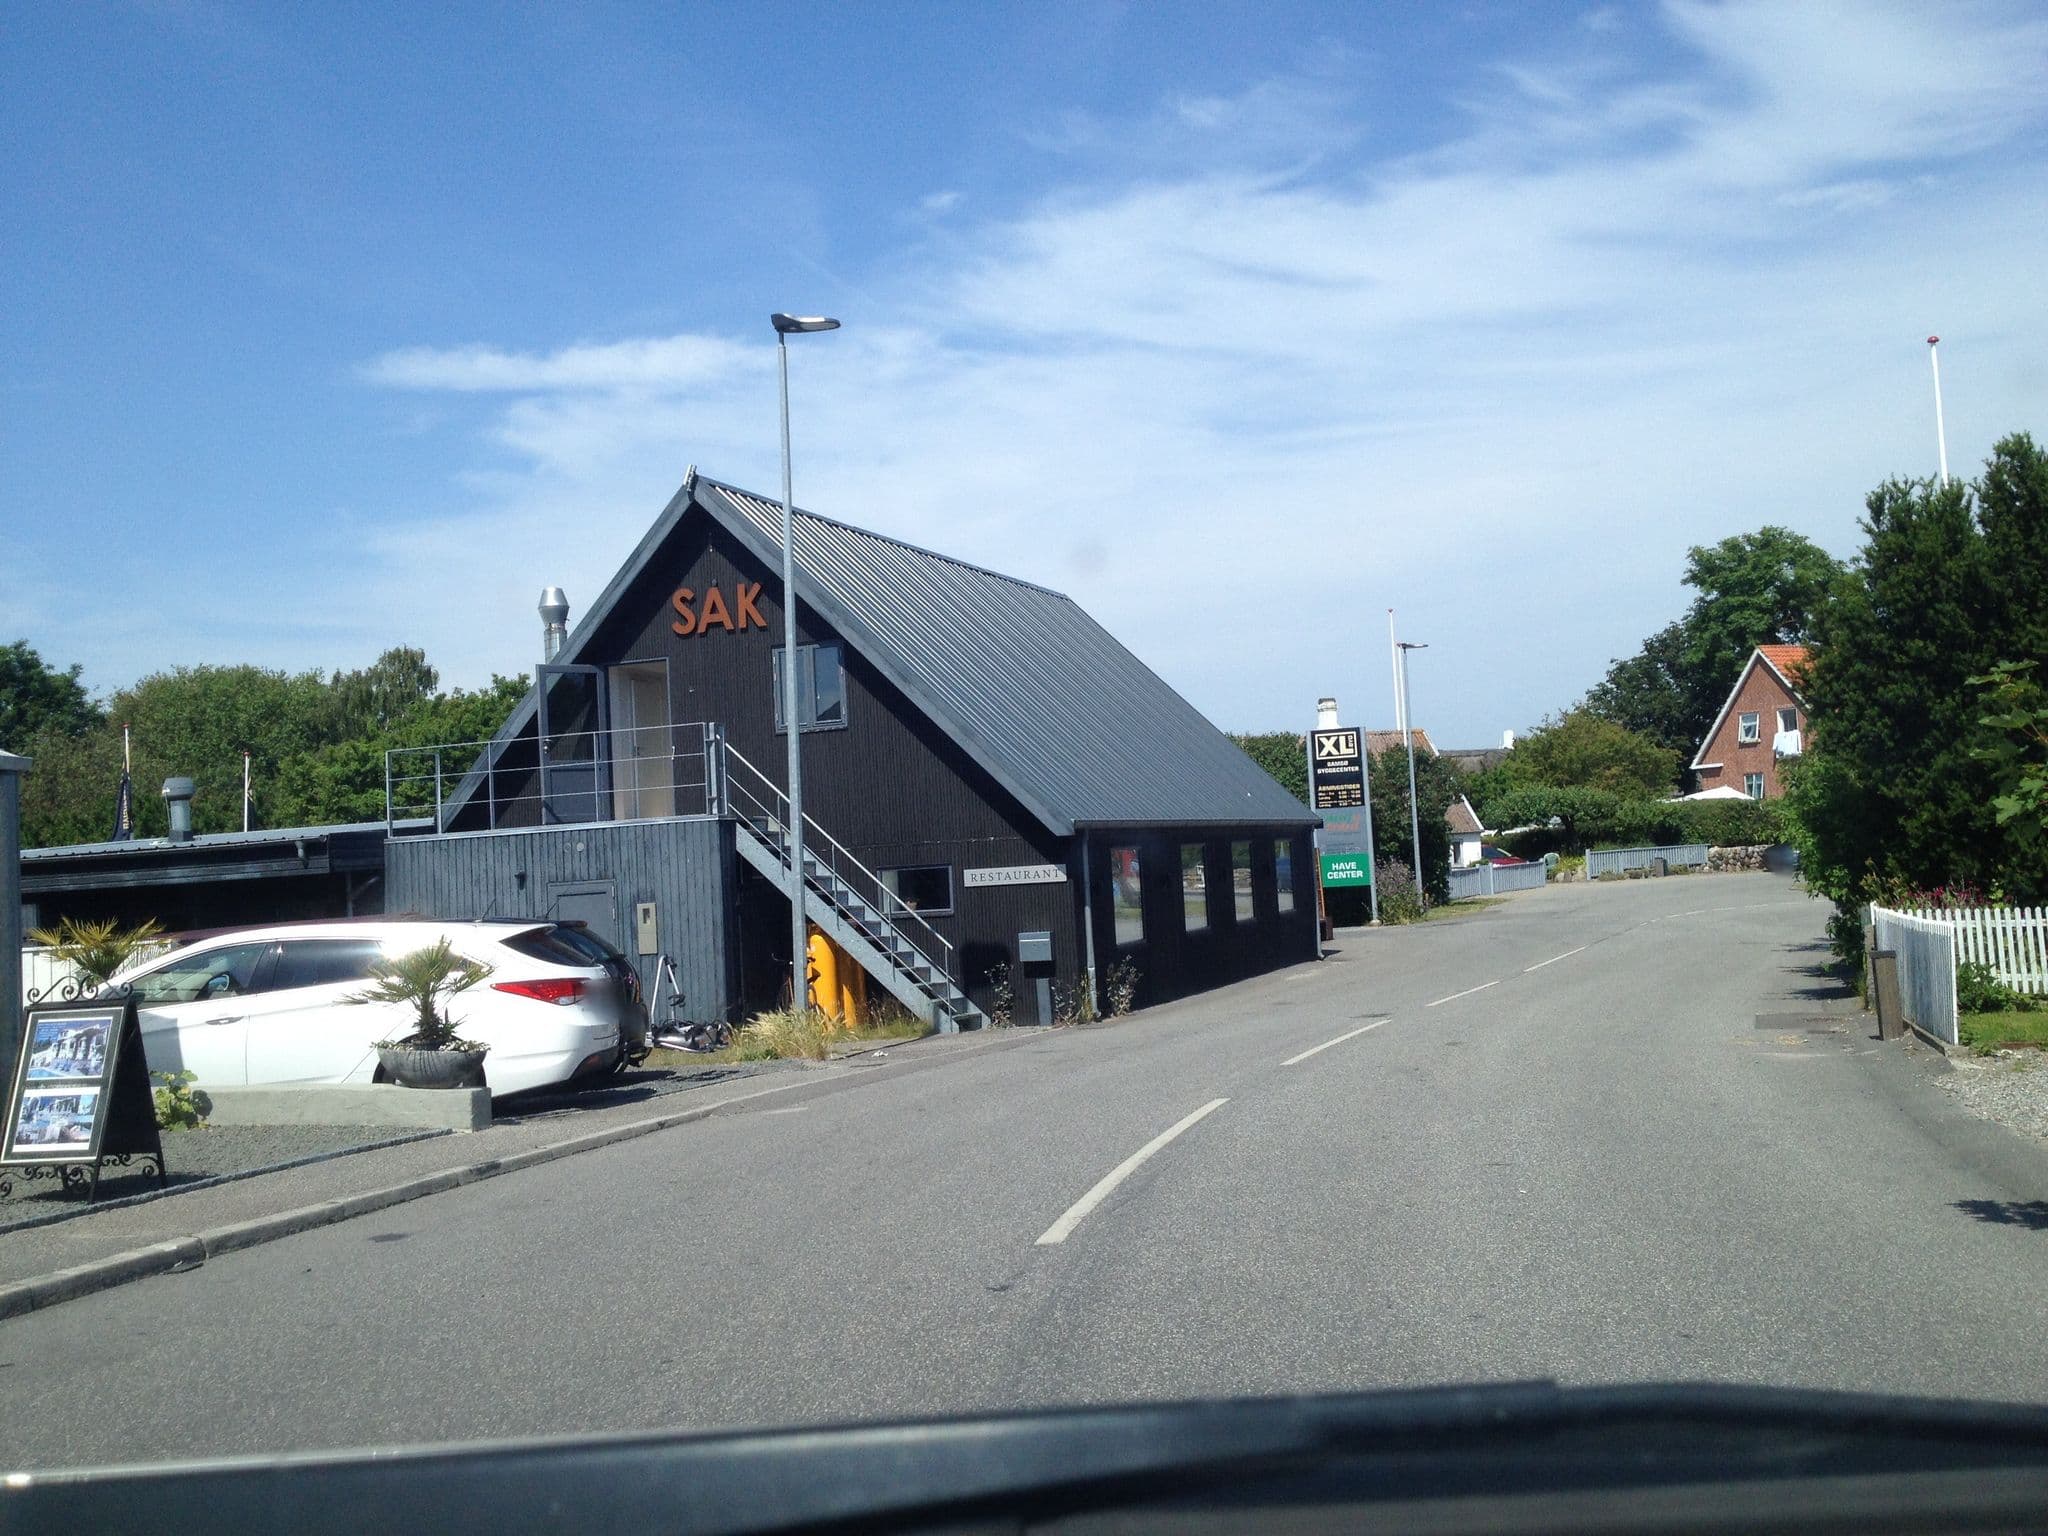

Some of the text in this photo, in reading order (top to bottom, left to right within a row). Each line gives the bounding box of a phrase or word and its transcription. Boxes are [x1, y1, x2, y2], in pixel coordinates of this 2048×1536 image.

[671, 582, 768, 635] SAK
[1319, 736, 1354, 756] XL
[1332, 862, 1357, 870] HAVE
[970, 868, 1061, 883] RESTAURANT
[1327, 871, 1363, 879] CENTER
